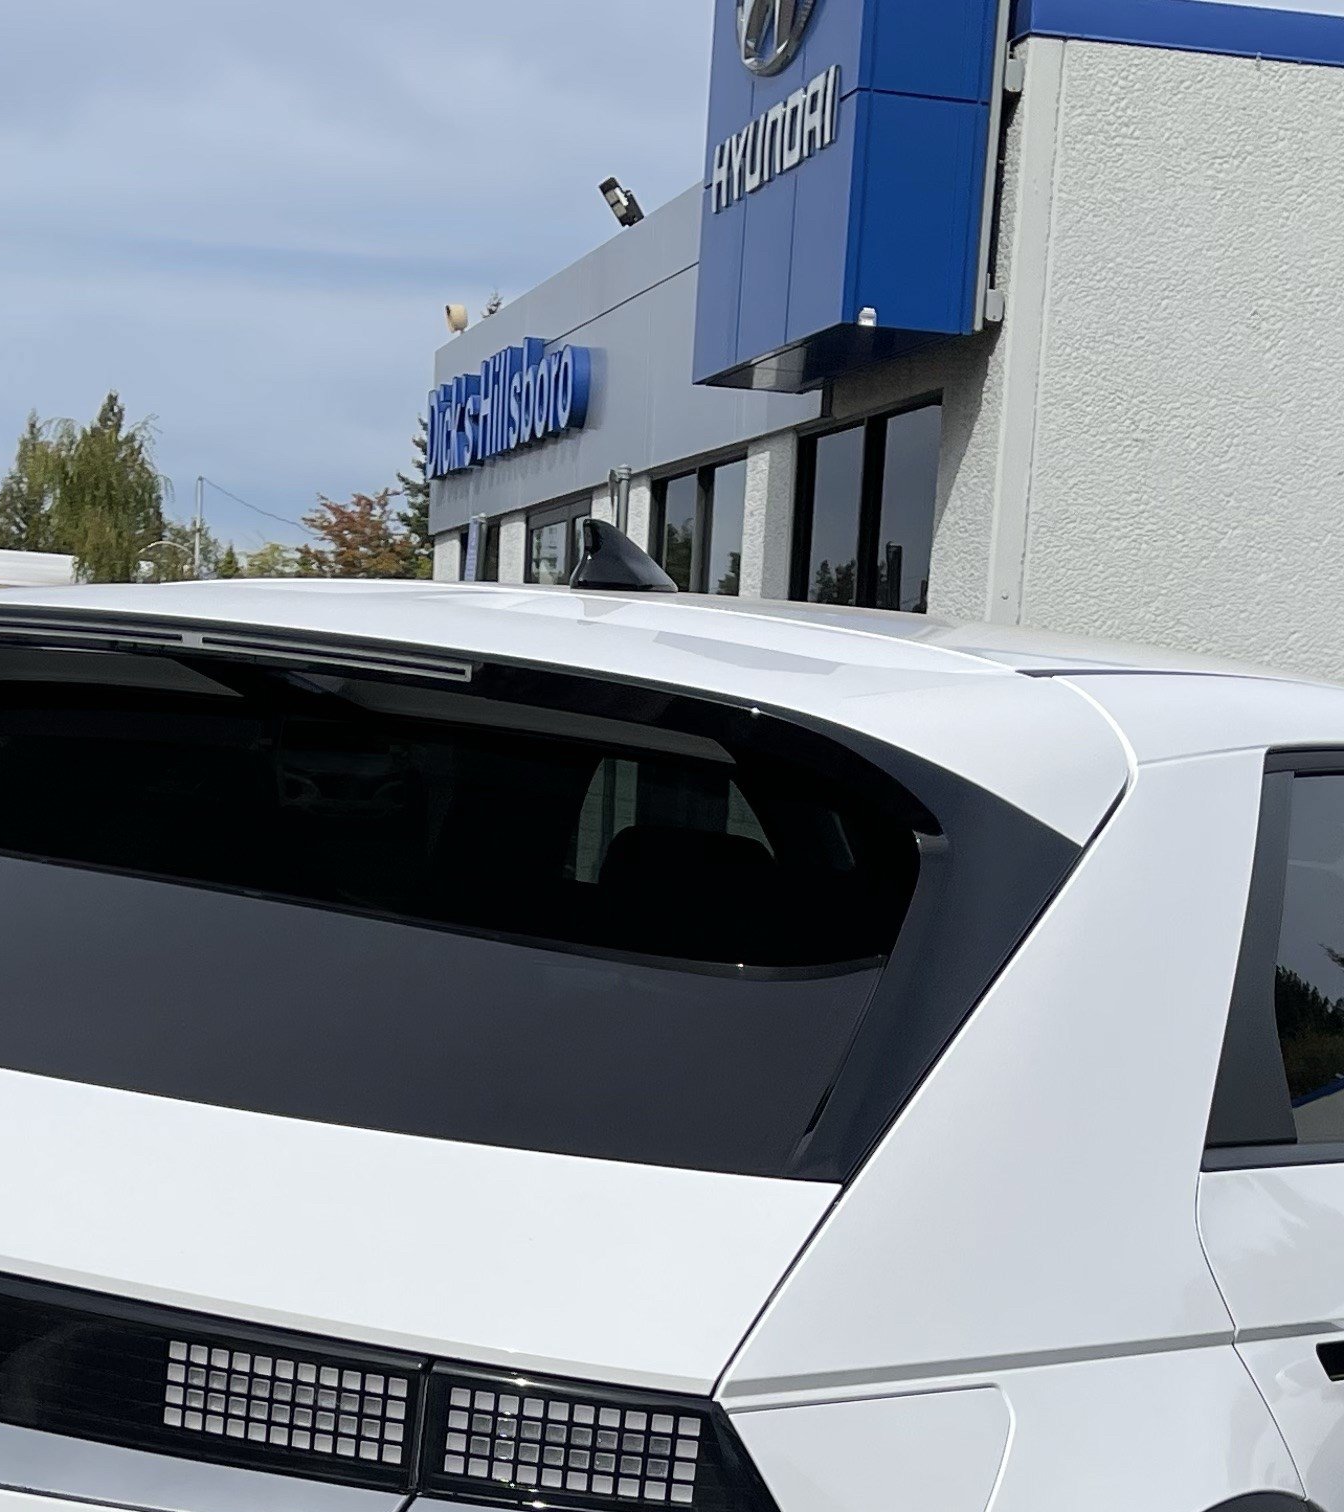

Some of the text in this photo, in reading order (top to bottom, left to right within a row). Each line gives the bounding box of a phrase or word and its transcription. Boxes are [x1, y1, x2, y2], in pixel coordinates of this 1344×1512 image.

[712, 64, 840, 214] HYUNDAI
[426, 337, 586, 479] Dick's Hillsboro
